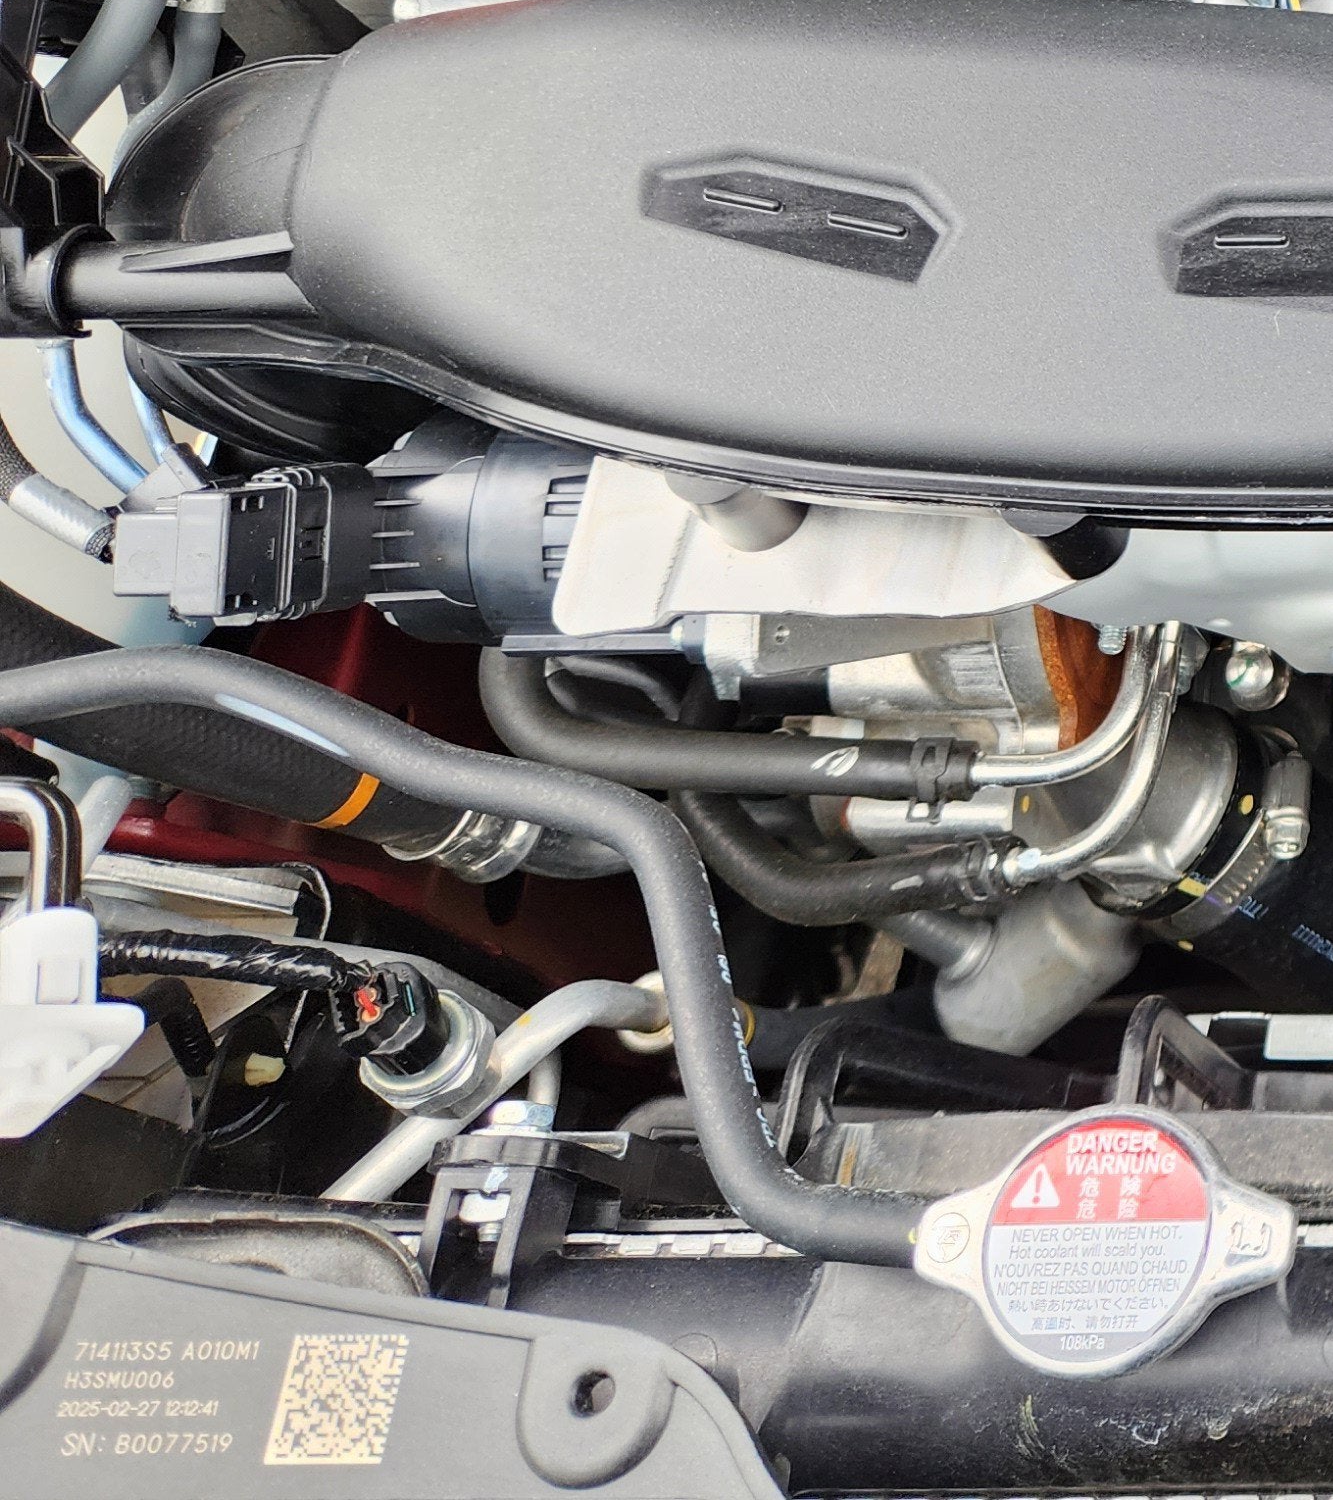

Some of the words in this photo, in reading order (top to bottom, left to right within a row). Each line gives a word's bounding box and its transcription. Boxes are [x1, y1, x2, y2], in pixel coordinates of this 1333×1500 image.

[1066, 1131, 1159, 1155] DANGER
[1066, 1153, 1177, 1176] WARNUNG
[1012, 1228, 1058, 1243] NEVER
[1062, 1227, 1101, 1242] OPEN
[1105, 1226, 1148, 1241] WHEN
[1148, 1225, 1183, 1240] HOT.
[1009, 1246, 1031, 1260] Hot
[1034, 1244, 1078, 1259] coolant
[1081, 1243, 1101, 1258] will
[1104, 1243, 1137, 1257] scald
[1139, 1245, 1167, 1260] you.
[993, 1263, 1061, 1279] N'OUVREZ
[1062, 1262, 1089, 1277] PAS
[1091, 1261, 1139, 1276] QUAND
[1141, 1259, 1190, 1275] CHAUD.
[997, 1281, 1030, 1296] NICHT
[1031, 1280, 1048, 1295] BEI
[1050, 1279, 1095, 1295] HEISSEM
[1097, 1278, 1136, 1294] MOTOR
[73, 1341, 173, 1361] 714113S5
[180, 1341, 260, 1361] A010M1
[1059, 1334, 1106, 1351] 108kPa
[63, 1371, 175, 1389] H3SMU006
[56, 1400, 160, 1418] 2025-02-27
[164, 1400, 219, 1418] 12:12:41
[60, 1432, 107, 1457] SN:
[114, 1432, 234, 1455] B0077519
